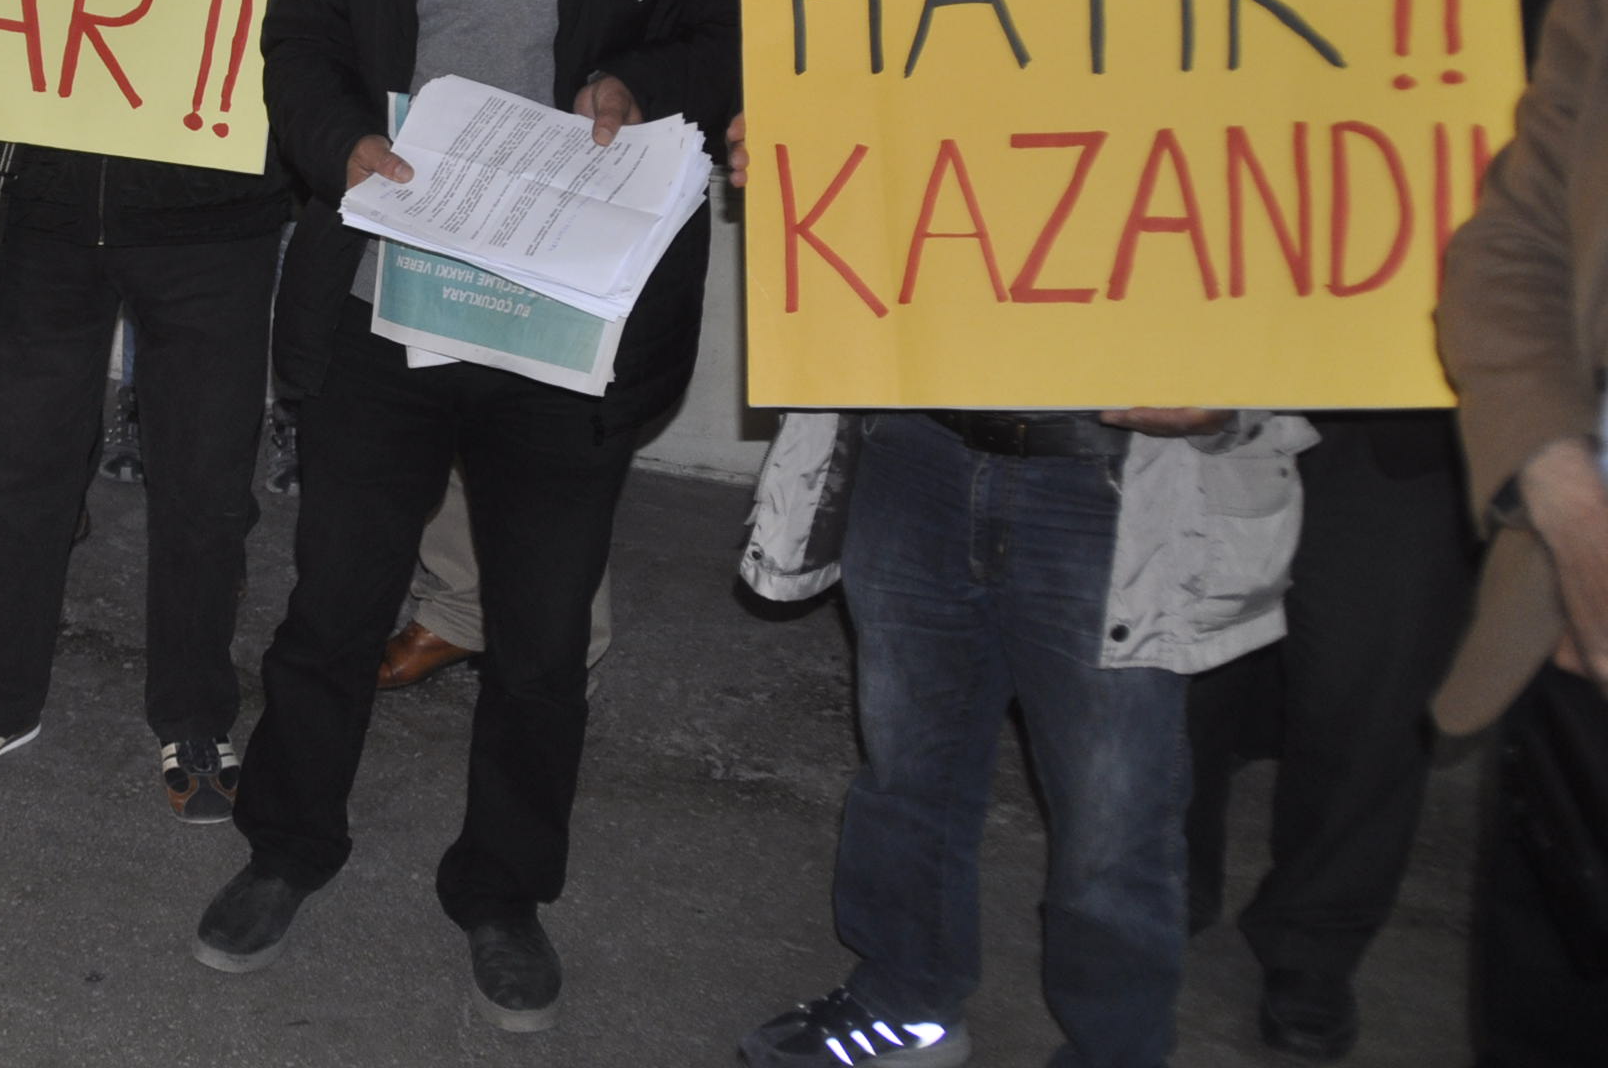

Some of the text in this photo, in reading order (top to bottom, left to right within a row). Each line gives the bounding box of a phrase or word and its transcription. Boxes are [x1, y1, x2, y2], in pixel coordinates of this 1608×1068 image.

[395, 255, 433, 275] VEREN
[434, 263, 474, 283] HAKKI
[442, 286, 513, 314] ÇOCUKLARA
[515, 303, 531, 318] BU
